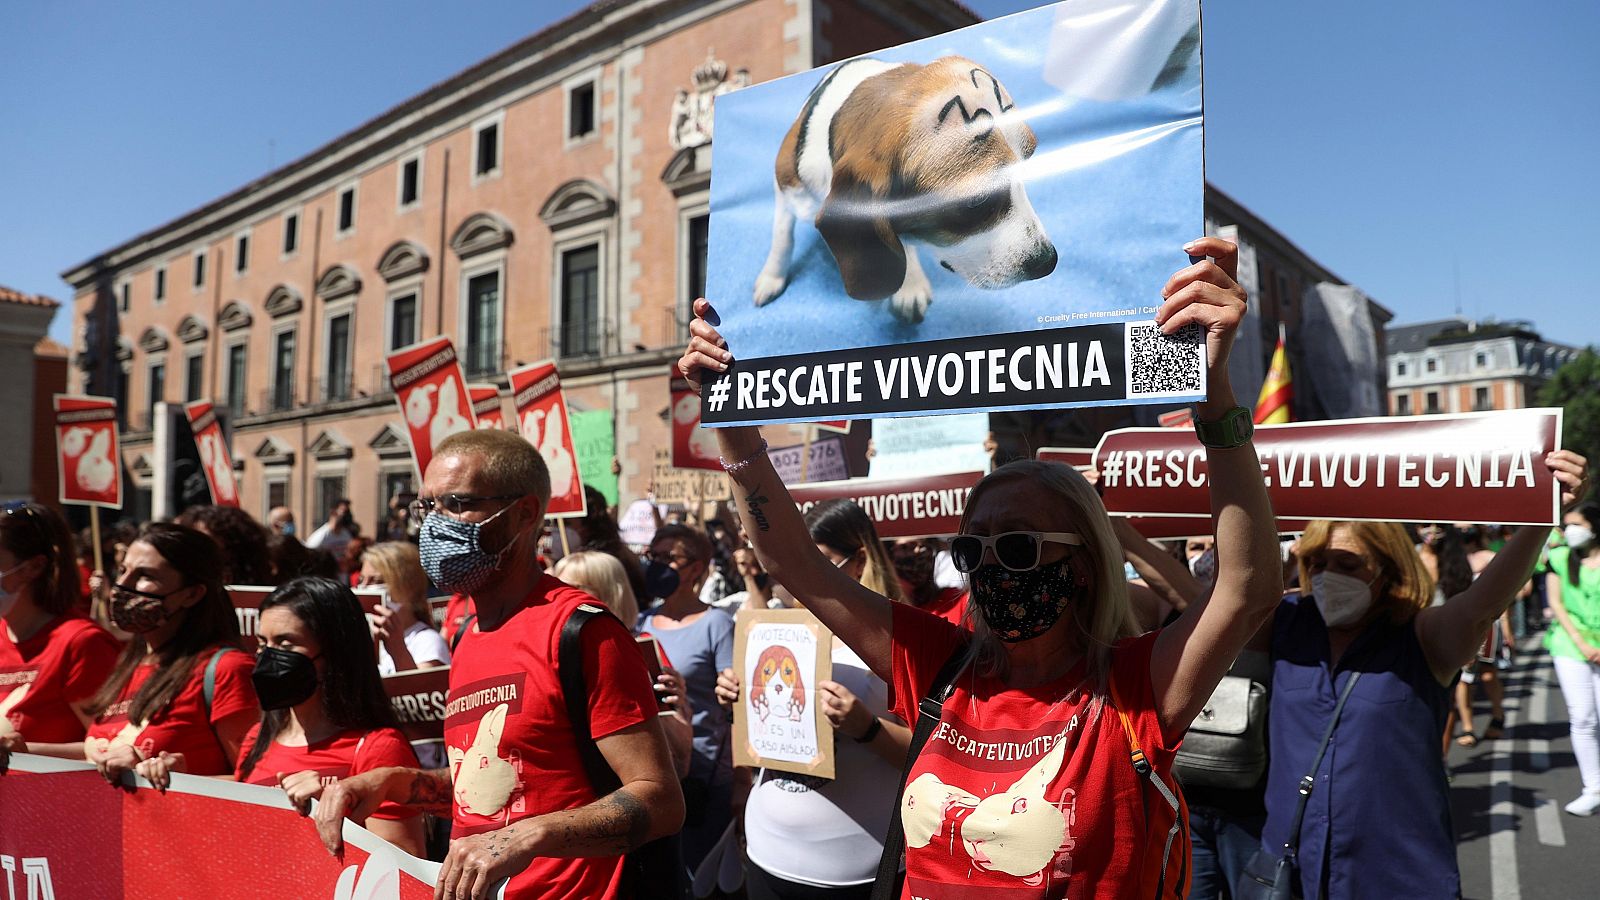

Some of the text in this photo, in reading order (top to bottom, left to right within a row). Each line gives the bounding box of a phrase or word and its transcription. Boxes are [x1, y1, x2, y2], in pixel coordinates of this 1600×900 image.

[1044, 314, 1070, 323] Cruelty
[1072, 311, 1088, 320] Free
[1089, 308, 1137, 318] International
[737, 361, 863, 410] RESCATE
[873, 340, 1112, 400] VIVOTECNIA
[1102, 448, 1536, 488] #RESCEVIVOTECNIA
[770, 723, 784, 737] ES
[790, 726, 806, 740] UN
[754, 739, 778, 752] CASO
